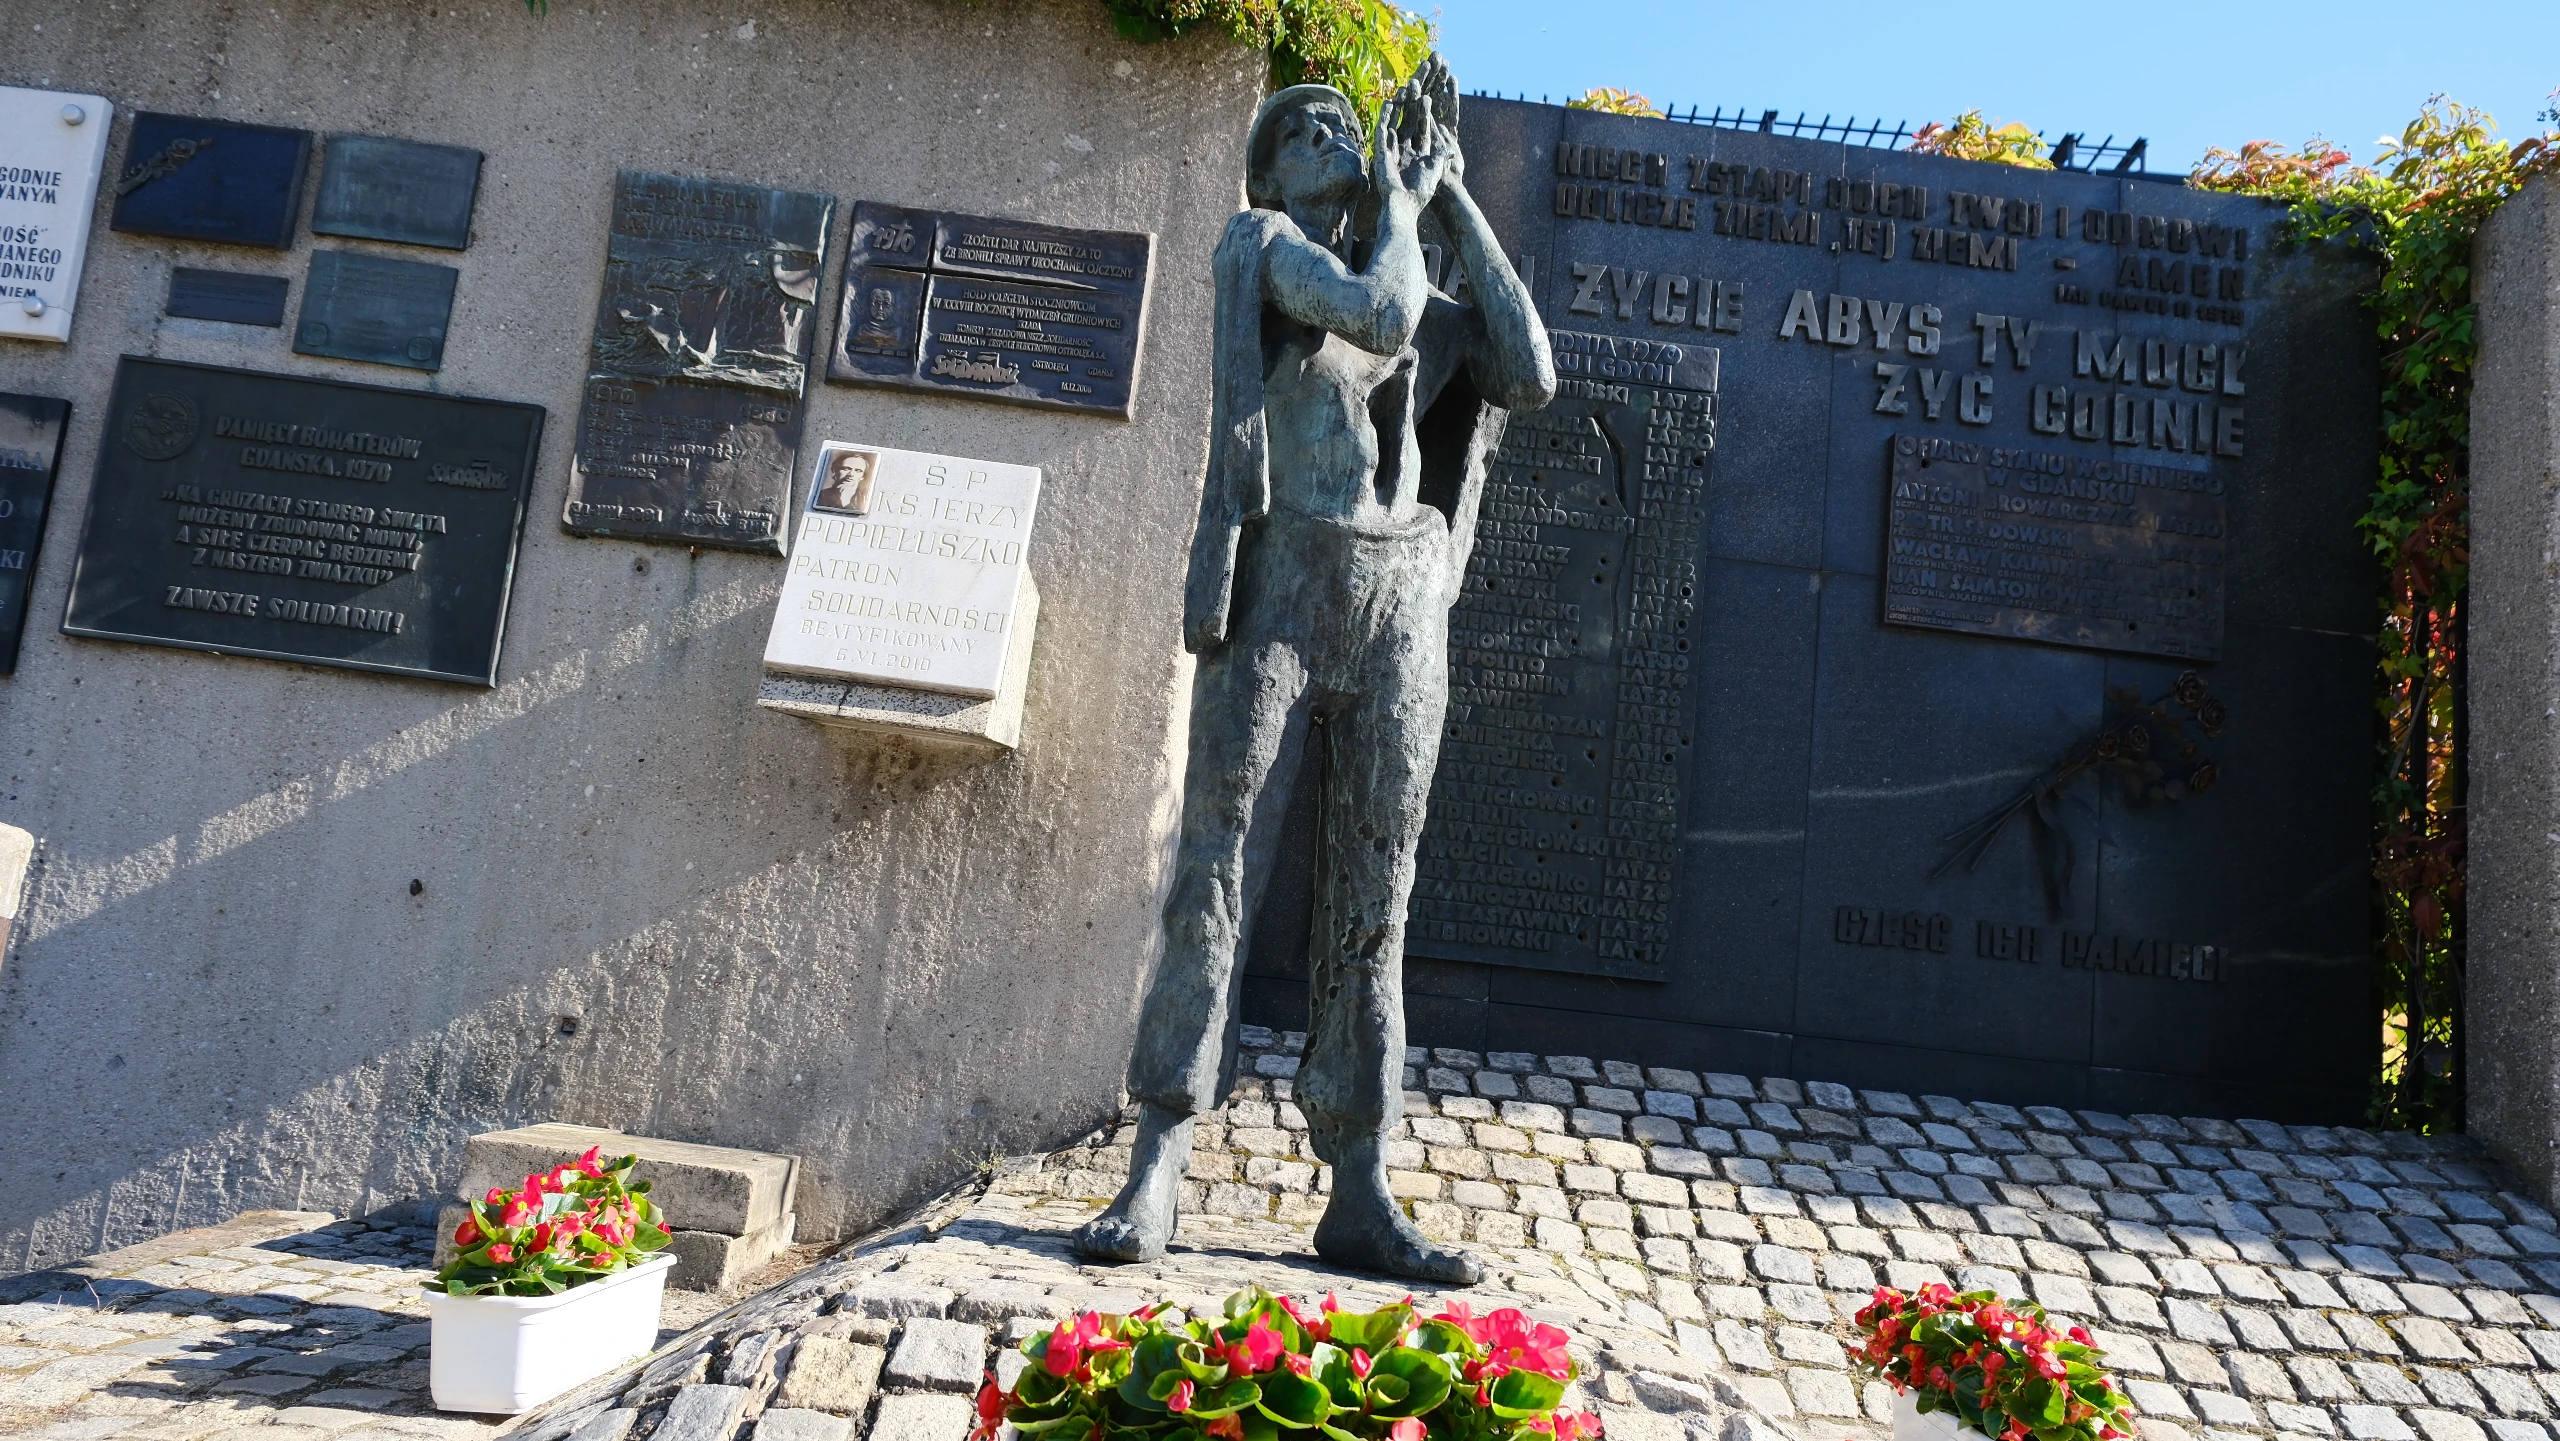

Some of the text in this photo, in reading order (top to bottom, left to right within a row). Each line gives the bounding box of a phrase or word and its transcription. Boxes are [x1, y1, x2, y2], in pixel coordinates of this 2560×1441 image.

[1557, 142, 1668, 185] NIECH
[1827, 176, 1928, 219] DUCH
[2057, 205, 2069, 238] I
[2085, 208, 2247, 261] ODNOWI
[1001, 239, 1018, 250] DAR
[1076, 247, 1086, 258] ZA
[1089, 249, 1100, 260] TO
[1556, 182, 1697, 230] OBLICZE
[1715, 201, 1820, 244] ZIEMI
[1914, 226, 2018, 271] ZIEMI
[2120, 255, 2246, 301] AMEN
[0, 262, 55, 282] DNIKU
[957, 248, 992, 262] BRONILI
[995, 254, 1030, 266] SPRAWY
[1031, 258, 1085, 273] UKOCHANEJ
[932, 297, 941, 308] W
[1061, 313, 1121, 328] GRUDNIOWYCH
[1030, 296, 1096, 312] STOCZNIOWCOM
[1780, 288, 1942, 355] ABYŚ
[1976, 312, 2044, 367] TY
[1625, 340, 1682, 365] 1970
[1584, 355, 1591, 373] I
[1602, 354, 1672, 384] GDYNI
[1556, 379, 1629, 405] ILIŃSKI
[1652, 391, 1686, 410] LAT
[2033, 383, 2244, 457] GODNIE
[216, 416, 298, 446] PAMIĘCI
[301, 426, 422, 459] BOHATERÓW
[345, 459, 392, 483] 1970
[1496, 446, 1601, 475] ODLEWSKI
[1643, 464, 1678, 483] LAT
[1898, 436, 2225, 495] OFIARY STANU WOJENNEGO
[1985, 466, 2010, 486] W
[207, 489, 292, 514] GRUZACH
[295, 498, 375, 524] STAREGO
[1896, 482, 1979, 507] ANTONI
[261, 515, 360, 541] ZBUDOWAĆ
[929, 497, 1025, 529] JERZY
[1487, 501, 1635, 534] LEWANDOWSKI
[1637, 520, 1672, 539] LAT
[1893, 510, 1953, 533] PIOTR
[175, 525, 190, 543] A
[246, 534, 326, 558] CZERPAĆ
[801, 516, 1020, 566] POPIEŁUSZKO
[1893, 538, 1992, 566] WACŁAW
[192, 548, 207, 565] Z
[211, 552, 292, 575] NASZEGO
[793, 555, 901, 586] PATRON
[165, 586, 404, 634] ZAWSZE SOLIDARNI!
[805, 590, 1006, 634] SOLIDARNOŚCI
[1629, 611, 1663, 632] LAT
[800, 620, 976, 655] BEATYFIKOWANY
[1448, 609, 1557, 639] PIERNICKI
[1626, 630, 1660, 650] LAT
[1466, 650, 1544, 674] POLITO
[1621, 667, 1656, 685] LAT
[1481, 669, 1569, 696] REBININ
[1619, 685, 1655, 704] LAT
[1604, 877, 1640, 900] LAT
[1602, 896, 1639, 919] LAT
[1977, 920, 2043, 964] ICH
